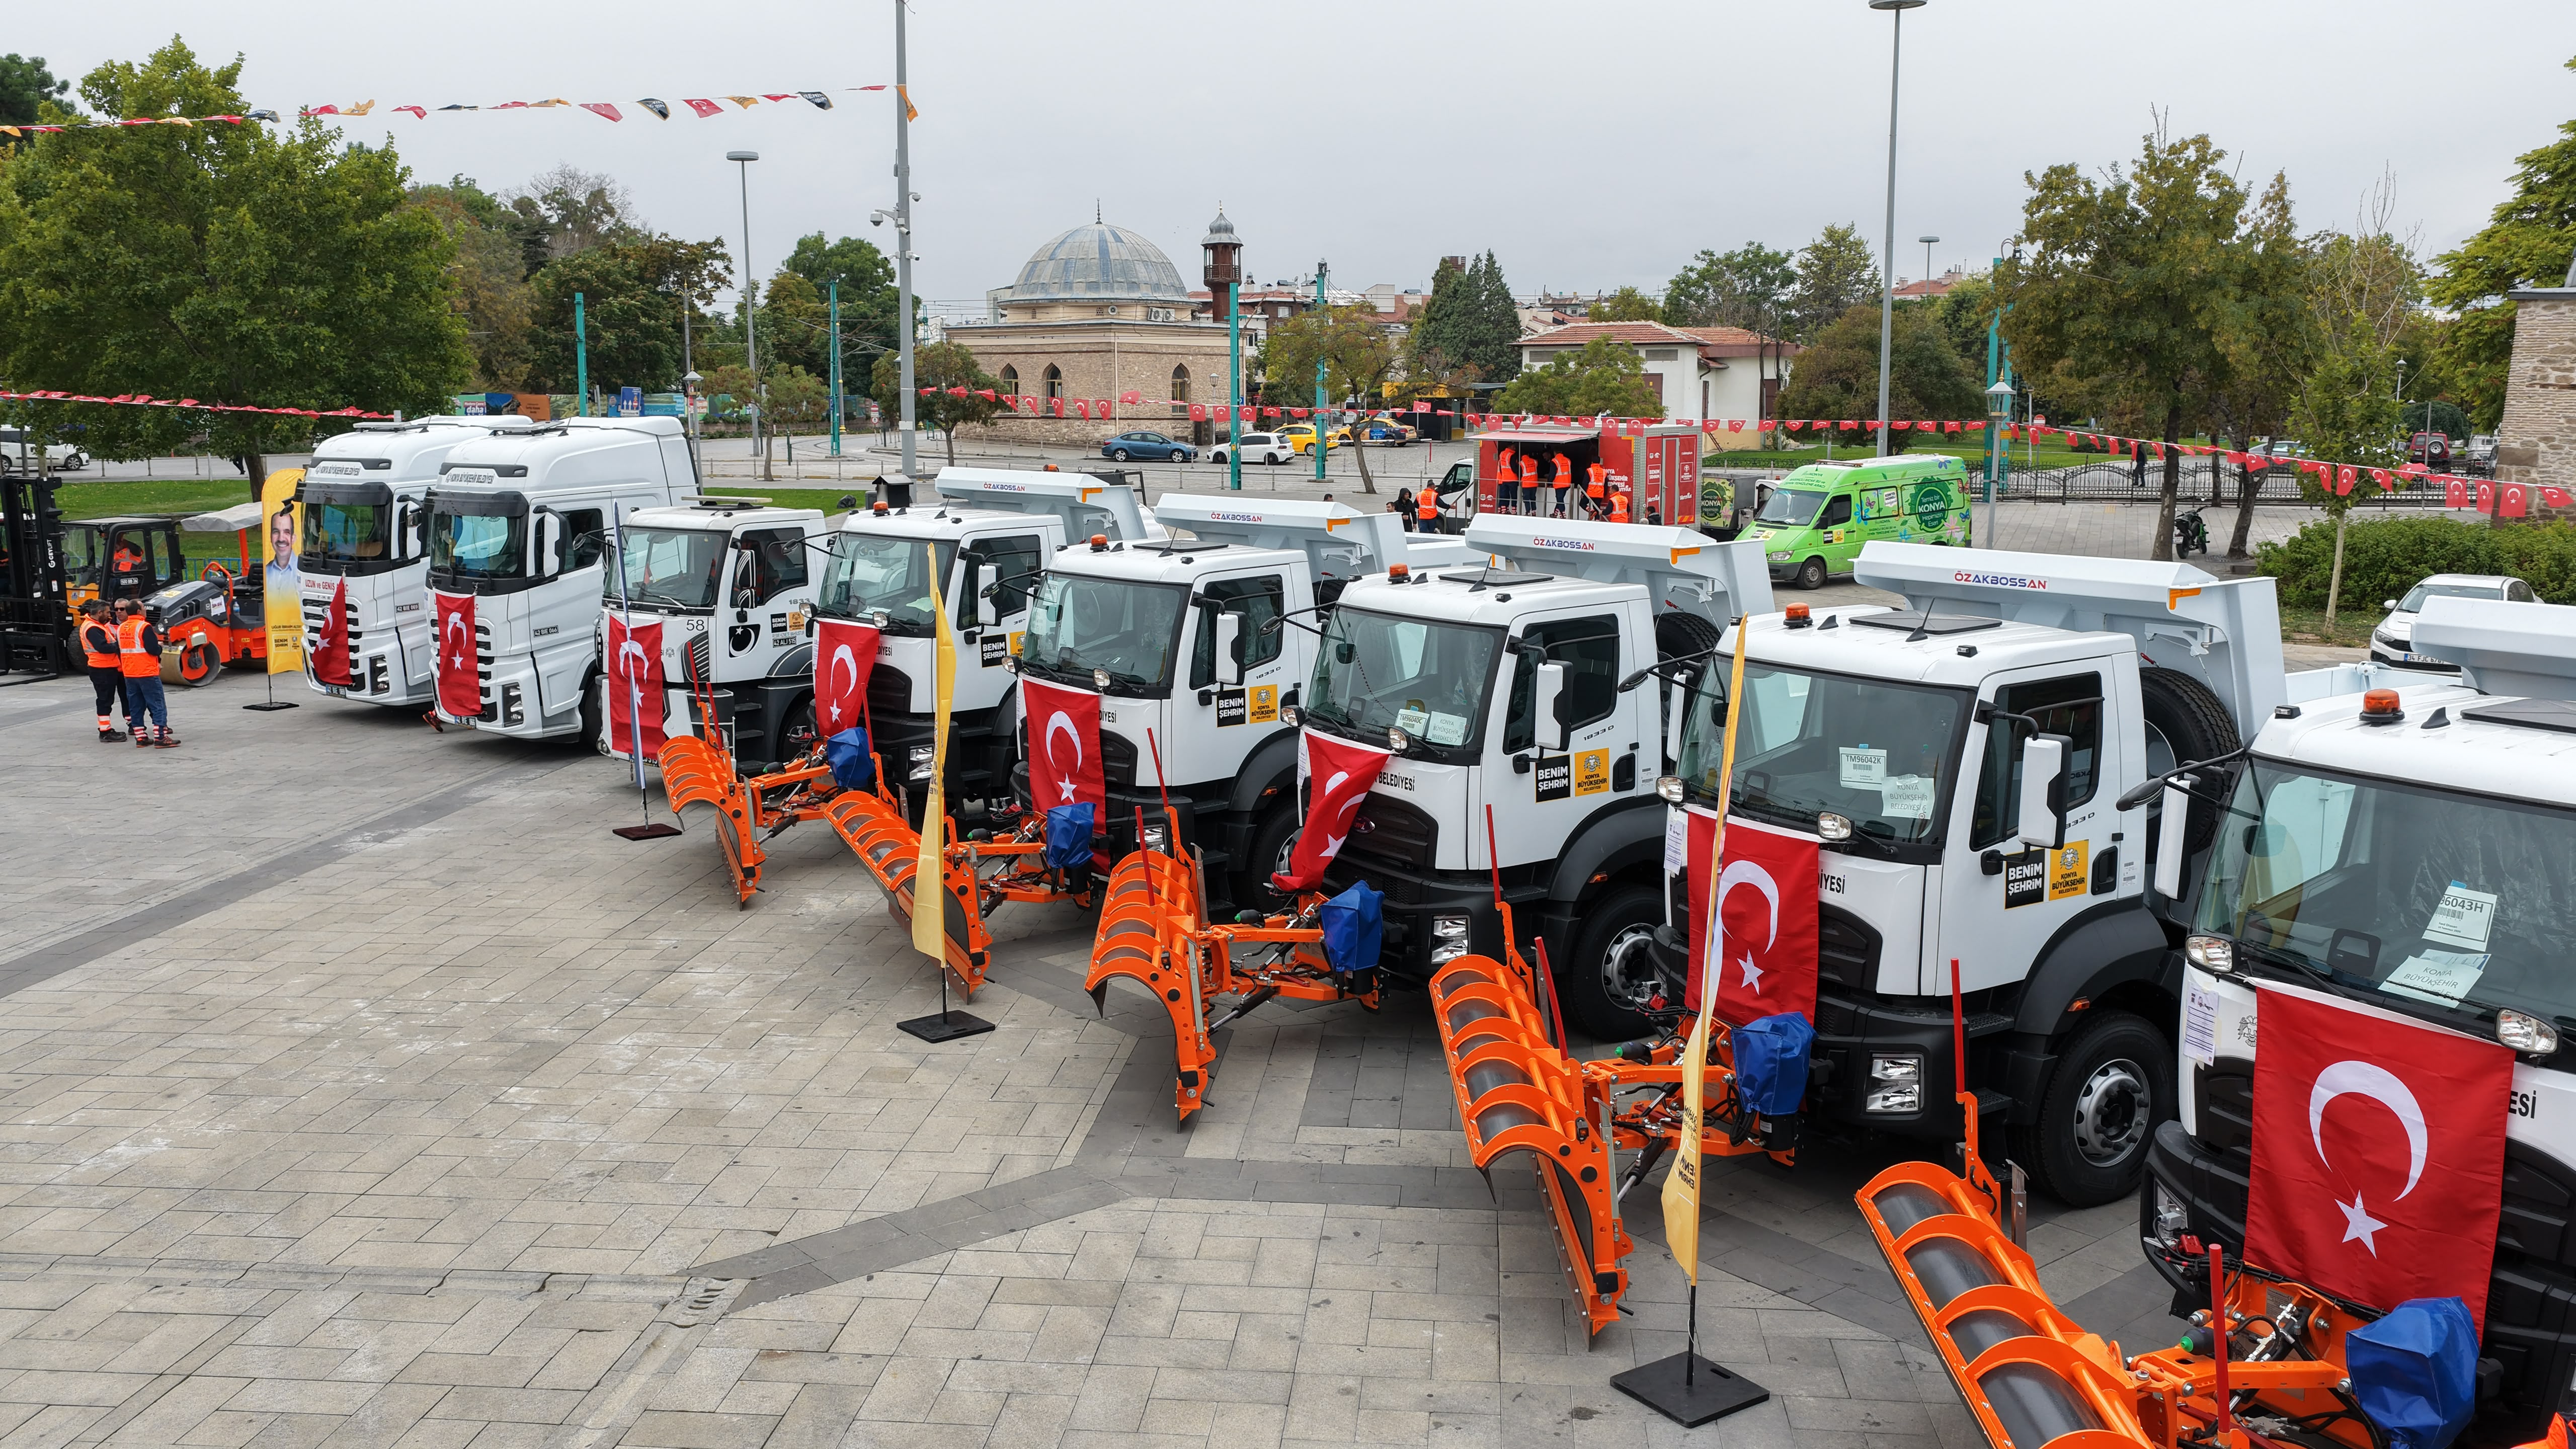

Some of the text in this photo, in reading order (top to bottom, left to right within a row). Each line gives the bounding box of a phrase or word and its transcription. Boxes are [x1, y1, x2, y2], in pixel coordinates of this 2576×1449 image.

[984, 482, 1025, 491] ÖZAKBOSSAN
[1918, 501, 1946, 513] KONYA
[1211, 512, 1262, 522] ÖZAKBOSSAN
[1534, 536, 1594, 550] ÖZAKBOSSAN
[305, 580, 316, 588] UZUN
[322, 580, 335, 593] GENİŞ
[1955, 571, 2046, 590] ÖZAKBOSSAN
[686, 619, 705, 631] 58
[877, 643, 893, 656] DİYESİ
[1099, 708, 1116, 723] DİYESİ
[1251, 708, 1276, 716] BÜYÜKŞEHİR
[1400, 715, 1422, 724] TM96040C
[1433, 725, 1459, 735] BÜYÜKŞEHİR
[1583, 729, 1606, 741] 1833
[1431, 734, 1454, 742] BELEDİYESİ
[1846, 755, 1881, 764] TM96042K
[1379, 771, 1415, 792] BELEDİYESİ
[1577, 777, 1607, 788] BÜYÜKŞEHİR
[1890, 793, 1928, 801] BÜYÜKŞEHİR
[1891, 803, 1921, 811] BELEDİYESİ
[2061, 871, 2077, 879] KONYA
[1818, 869, 1845, 895] İYESİ
[2052, 877, 2085, 890] BÜYÜKŞEHİR
[2440, 896, 2483, 913] 96043H
[2423, 967, 2452, 976] KONYA
[2403, 974, 2458, 988] BÜYÜKŞEHİR
